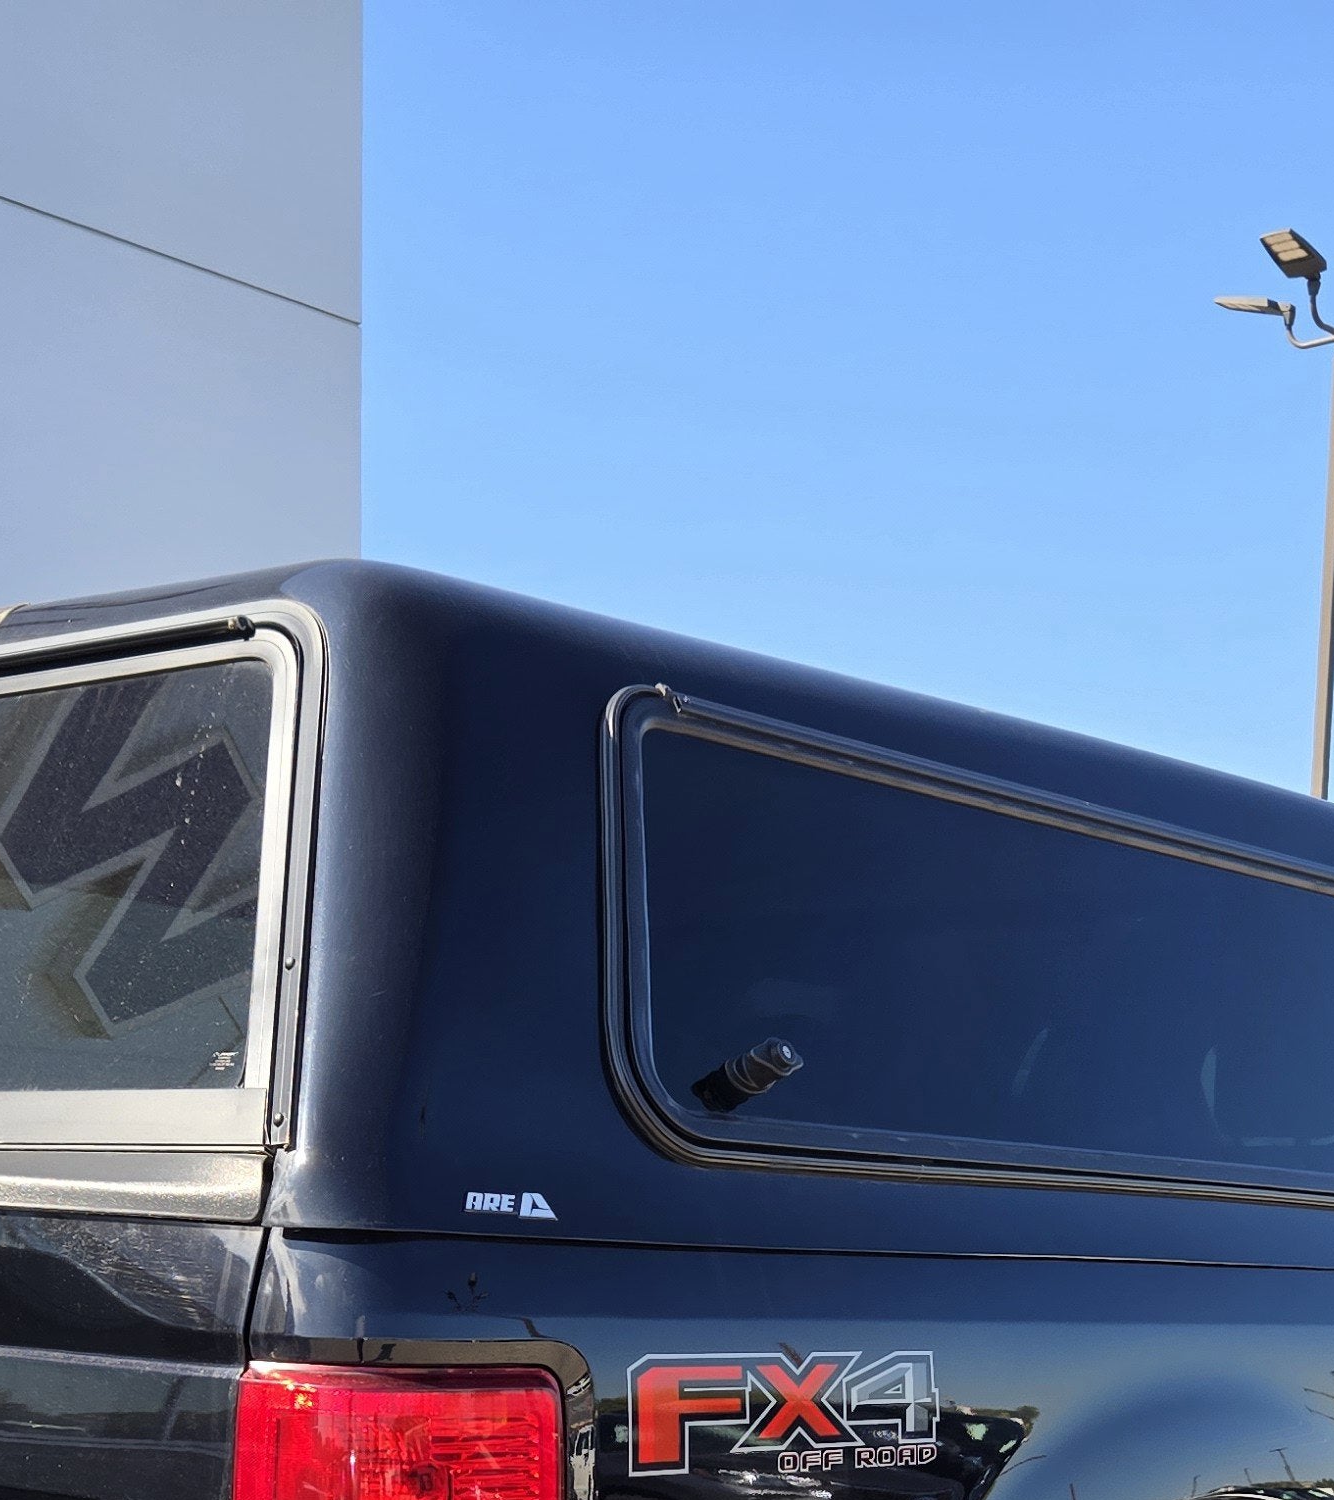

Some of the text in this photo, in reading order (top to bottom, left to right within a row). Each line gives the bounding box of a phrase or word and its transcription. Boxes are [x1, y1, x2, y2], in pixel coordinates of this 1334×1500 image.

[627, 1350, 940, 1477] FX4
[777, 1443, 938, 1473] OFF ROAD
